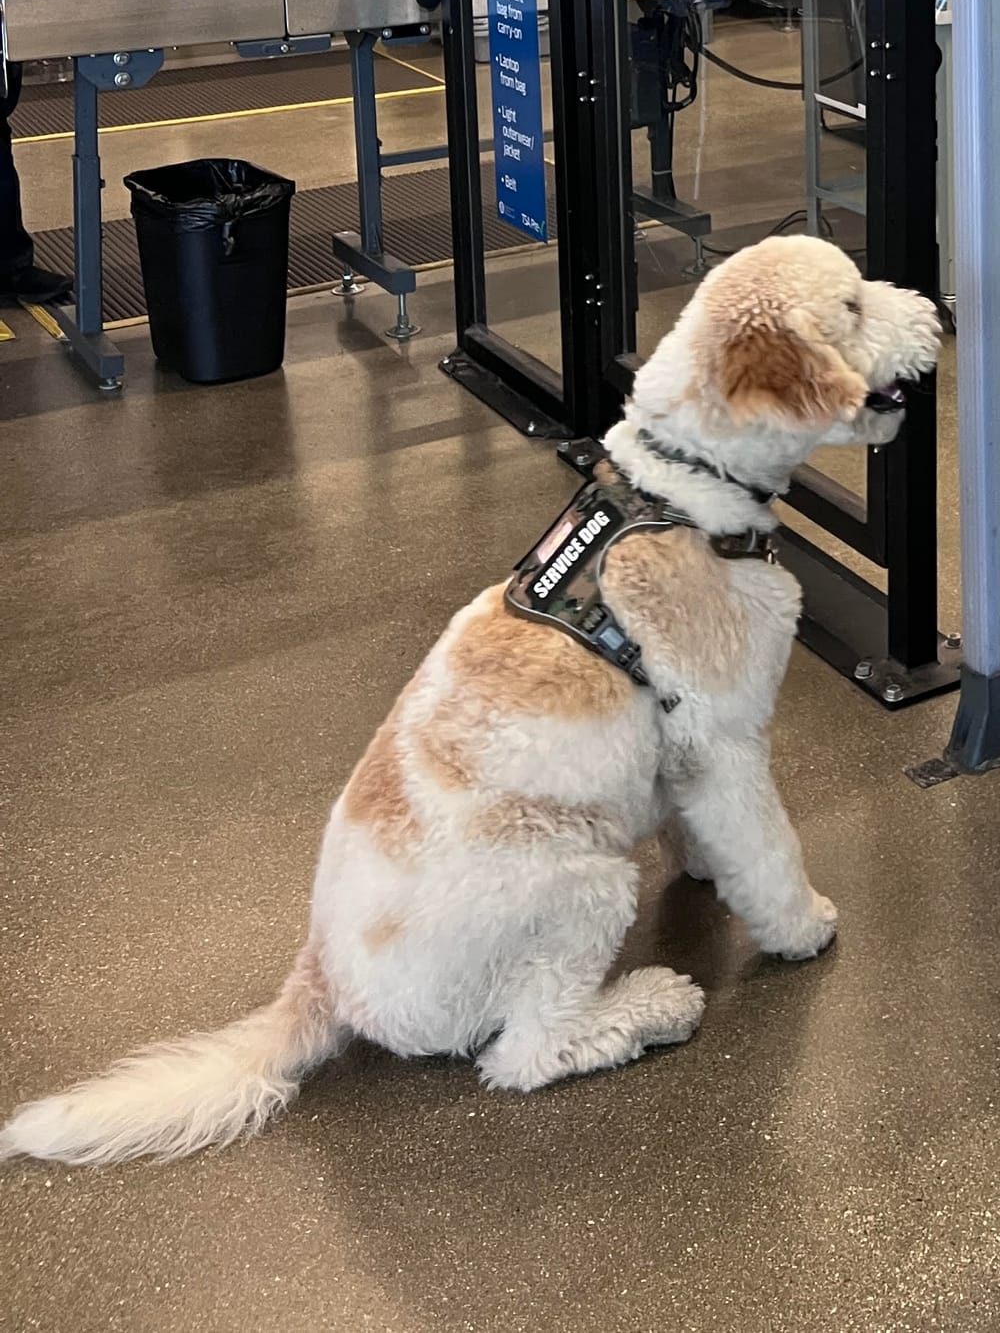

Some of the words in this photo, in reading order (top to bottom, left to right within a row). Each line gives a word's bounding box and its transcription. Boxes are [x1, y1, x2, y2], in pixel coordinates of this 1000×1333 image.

[496, 0, 508, 19] bag
[508, 4, 523, 21] from
[497, 22, 523, 40] carry-on
[499, 53, 520, 73] Laptop
[500, 70, 514, 89] from
[514, 76, 527, 96] bag
[501, 106, 517, 123] Light
[503, 141, 521, 162] jacket
[505, 174, 517, 192] Belt
[533, 537, 586, 598] SERVICE
[578, 510, 611, 544] DOG
